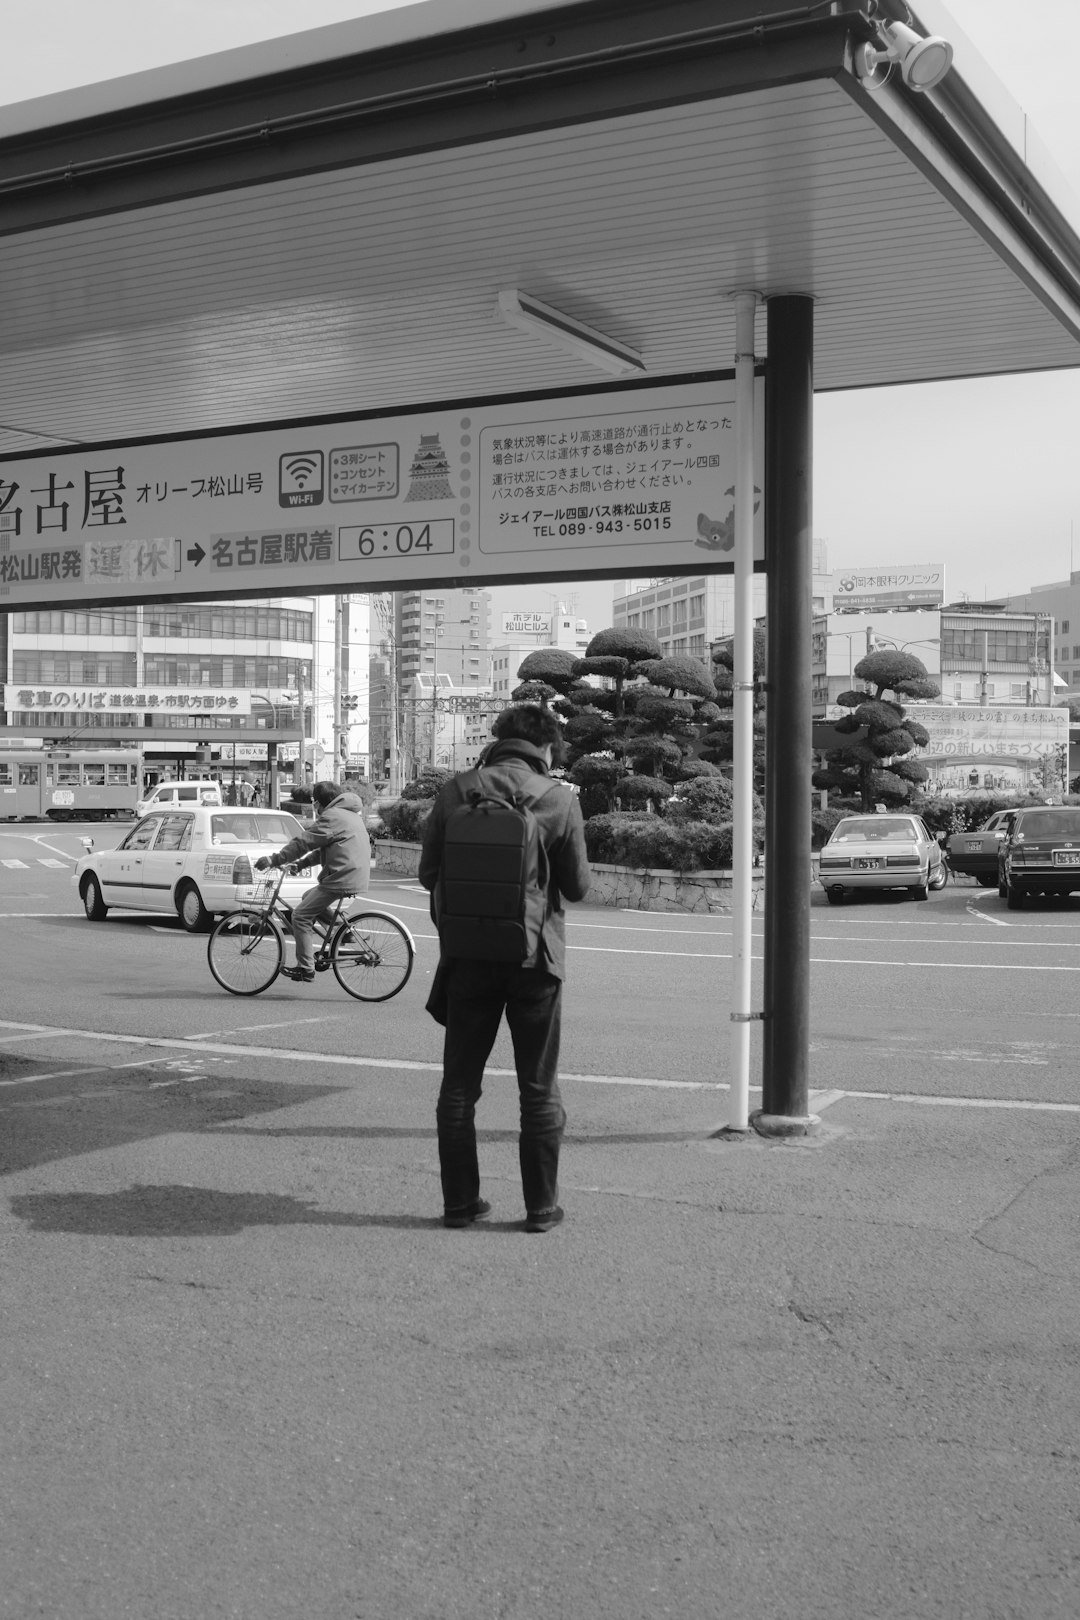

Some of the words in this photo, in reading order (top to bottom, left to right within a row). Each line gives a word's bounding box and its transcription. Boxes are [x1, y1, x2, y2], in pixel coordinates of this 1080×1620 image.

[493, 417, 732, 451] 気象状況等により高速道路が通行止めとなった
[340, 452, 385, 465] 3列シート
[493, 437, 692, 466] 場合はバスは運休する場合があります。
[340, 466, 385, 481] コンセント
[493, 455, 720, 486] 運行状況につきましては、ジェイアール四国
[136, 473, 264, 503] オリーブ松山号
[340, 481, 396, 496] マイカーテン
[492, 475, 692, 500] バスの各支店へお問い合わせください。
[289, 494, 314, 505] Wi-Fi
[358, 523, 434, 556] 6:04
[533, 525, 556, 537] TEL
[211, 529, 333, 568] 名古屋駅着
[0, 549, 82, 583] 松山駅発
[89, 543, 171, 578] 運休
[855, 573, 940, 588] 岡本眼科クリニック
[513, 613, 542, 622] ホテル
[17, 689, 107, 708] 電車のりば
[912, 740, 1056, 757] 周辺の新しいまちづくり
